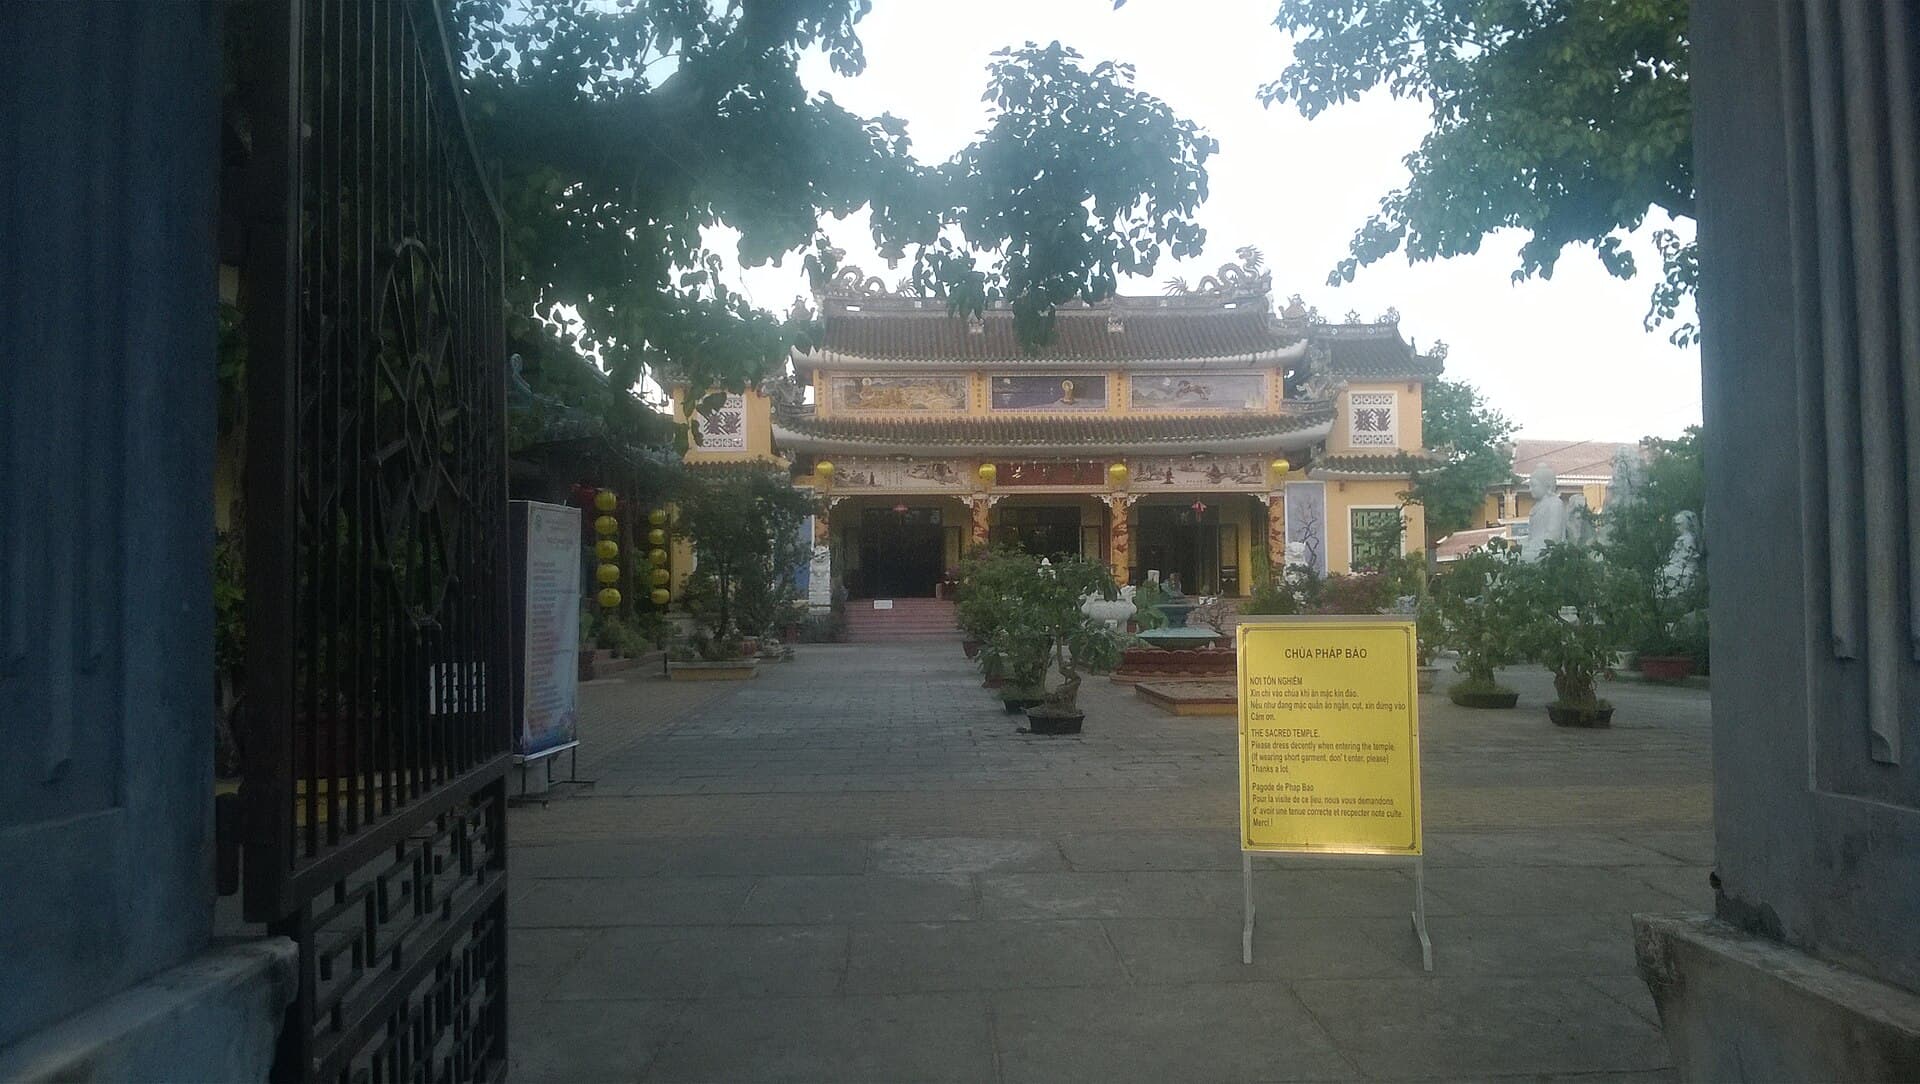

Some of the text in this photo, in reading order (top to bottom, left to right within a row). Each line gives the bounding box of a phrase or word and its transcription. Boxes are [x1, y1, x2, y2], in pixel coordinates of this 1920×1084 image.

[1251, 729, 1265, 737] THE
[1265, 729, 1291, 737] SACRED
[1251, 741, 1271, 749] Please
[1291, 742, 1316, 751] decently
[1335, 743, 1360, 752] entering
[1259, 754, 1282, 762] wearing
[1252, 764, 1273, 772] Thanks
[1252, 782, 1274, 792] Pagode
[1276, 783, 1284, 791] de
[1252, 794, 1266, 802] Pour
[1358, 796, 1393, 805] demandons
